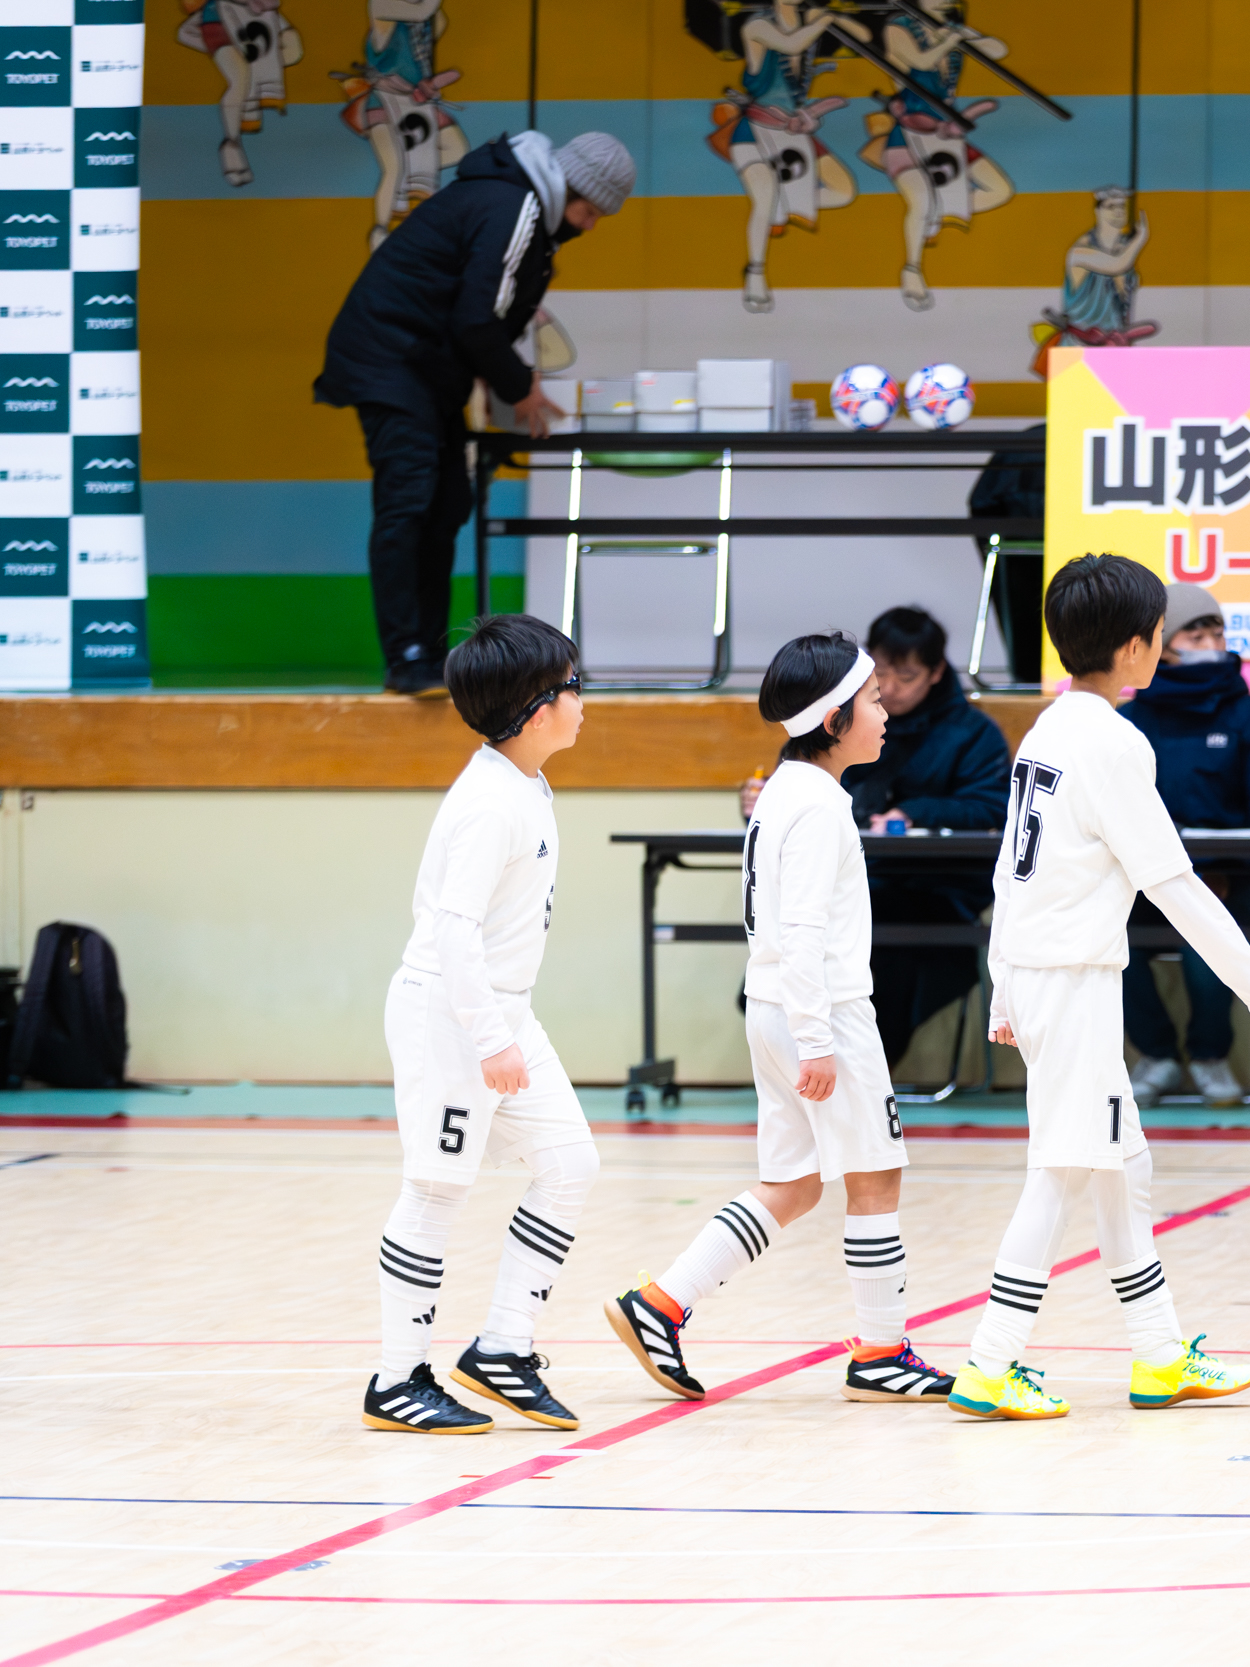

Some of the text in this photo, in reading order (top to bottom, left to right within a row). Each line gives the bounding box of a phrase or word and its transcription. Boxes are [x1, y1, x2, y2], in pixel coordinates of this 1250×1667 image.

[1012, 758, 1063, 882] 15
[438, 1104, 471, 1157] 5
[884, 1094, 903, 1141] 8
